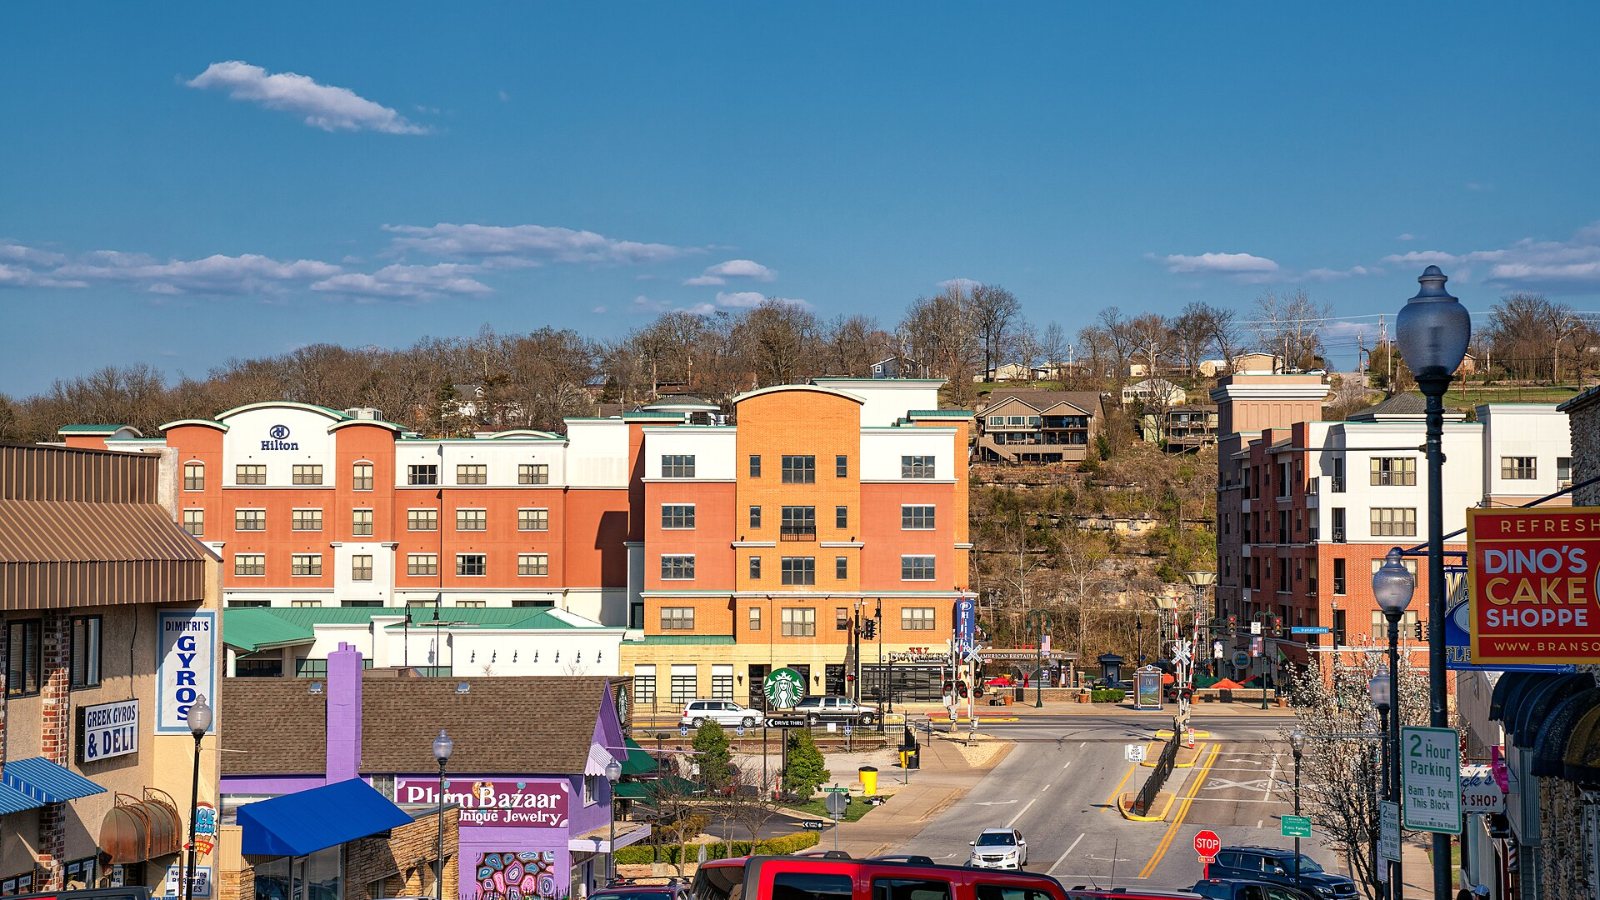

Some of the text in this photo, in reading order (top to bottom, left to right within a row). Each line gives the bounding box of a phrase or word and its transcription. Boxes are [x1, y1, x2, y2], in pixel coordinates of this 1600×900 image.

[261, 439, 299, 451] Hilton
[1484, 545, 1588, 574] DINO'S
[1485, 577, 1588, 606] CAKE
[165, 621, 209, 631] DIMITRI'S
[1486, 608, 1589, 628] SHOPPE
[87, 704, 136, 728] GREEK GYROS
[87, 726, 135, 758] & DELI
[1409, 734, 1452, 760] 2 Hour
[1410, 760, 1452, 782] Parking
[479, 786, 562, 809] Bazaar
[1408, 784, 1454, 799] 8am To 6pm
[1470, 794, 1497, 807] SHOP
[1412, 797, 1450, 811] This Block
[503, 810, 563, 826] Jewelry
[1196, 837, 1219, 849] STOP
